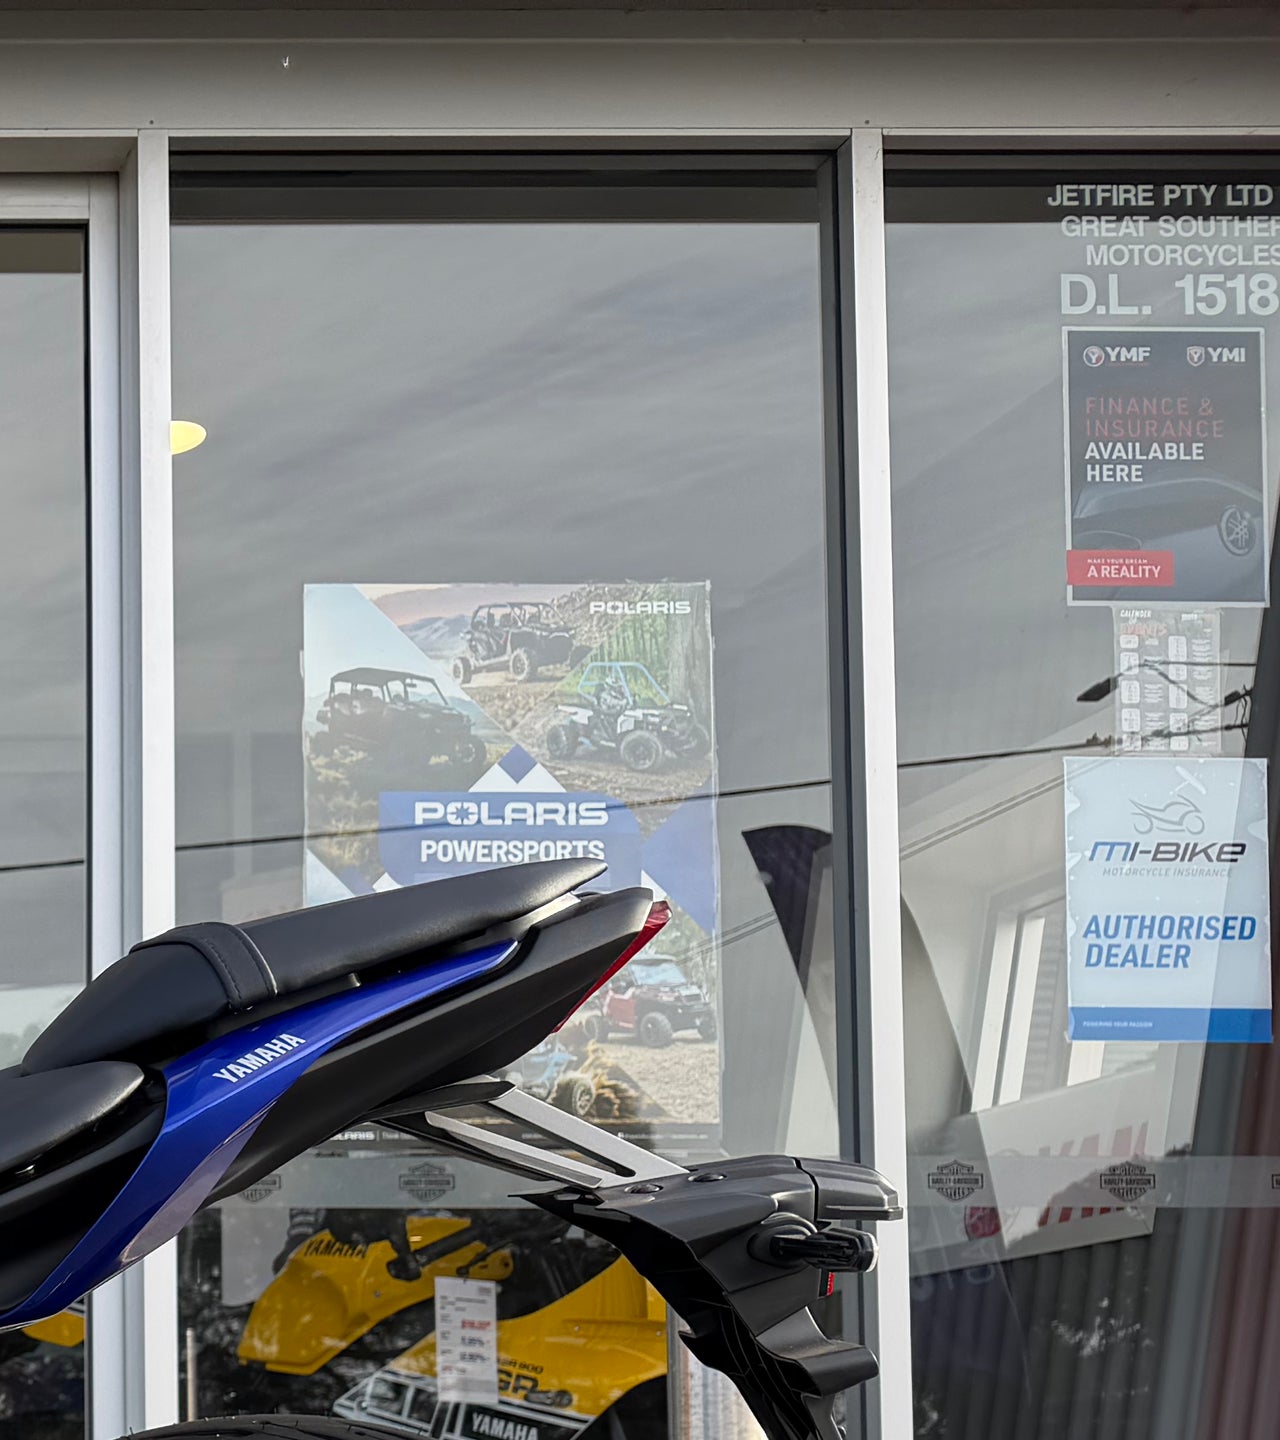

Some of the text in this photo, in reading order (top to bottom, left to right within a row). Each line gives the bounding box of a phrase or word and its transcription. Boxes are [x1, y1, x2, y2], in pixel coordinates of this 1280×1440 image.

[1047, 184, 1274, 206] JETFIRE PTY LTD
[1060, 215, 1150, 237] GREAT
[1060, 272, 1280, 316] D.L. 1518
[1105, 346, 1151, 363] YMF
[1207, 346, 1246, 363] YMI
[1085, 397, 1215, 417] FINANCE &
[1086, 419, 1224, 439] INSURANCE
[1084, 441, 1205, 461] AVAILABLE
[1086, 464, 1144, 482] HERE
[1087, 565, 1161, 578] A REALITY
[589, 600, 691, 615] POLARIS
[414, 801, 609, 826] POLARIS
[420, 839, 606, 863] POWERSPORTS
[1102, 867, 1171, 877] MOTORCYCLE
[1082, 914, 1257, 941] AUTHORISED
[1085, 943, 1192, 968] DEALER
[212, 1032, 307, 1084] YAMAHA
